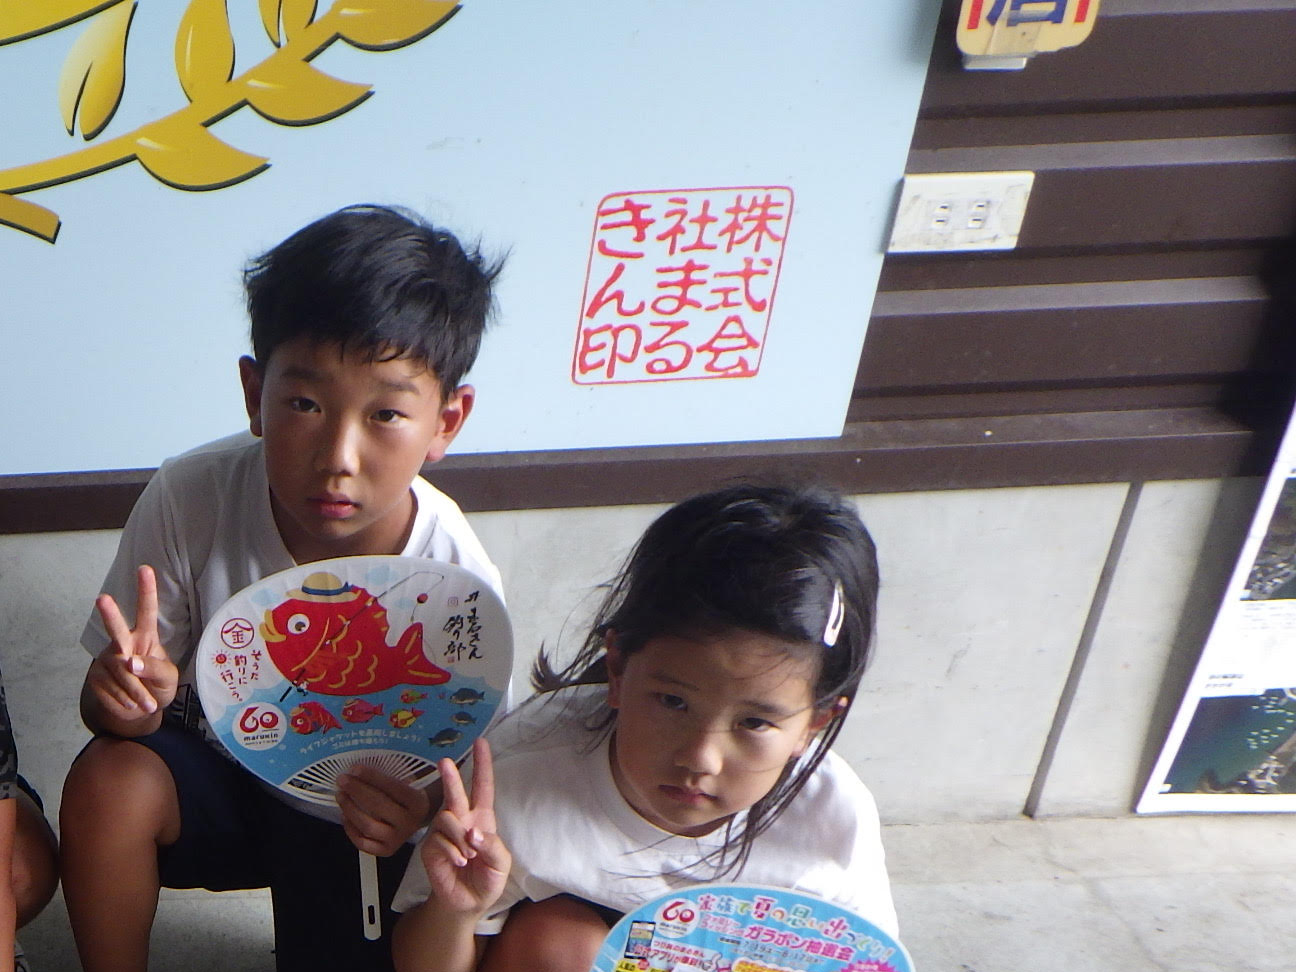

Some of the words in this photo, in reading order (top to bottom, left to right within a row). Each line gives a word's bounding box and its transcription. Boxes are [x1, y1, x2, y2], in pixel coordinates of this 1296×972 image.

[234, 654, 248, 685] 釣りに
[239, 706, 279, 733] 60
[243, 732, 279, 741] marukin
